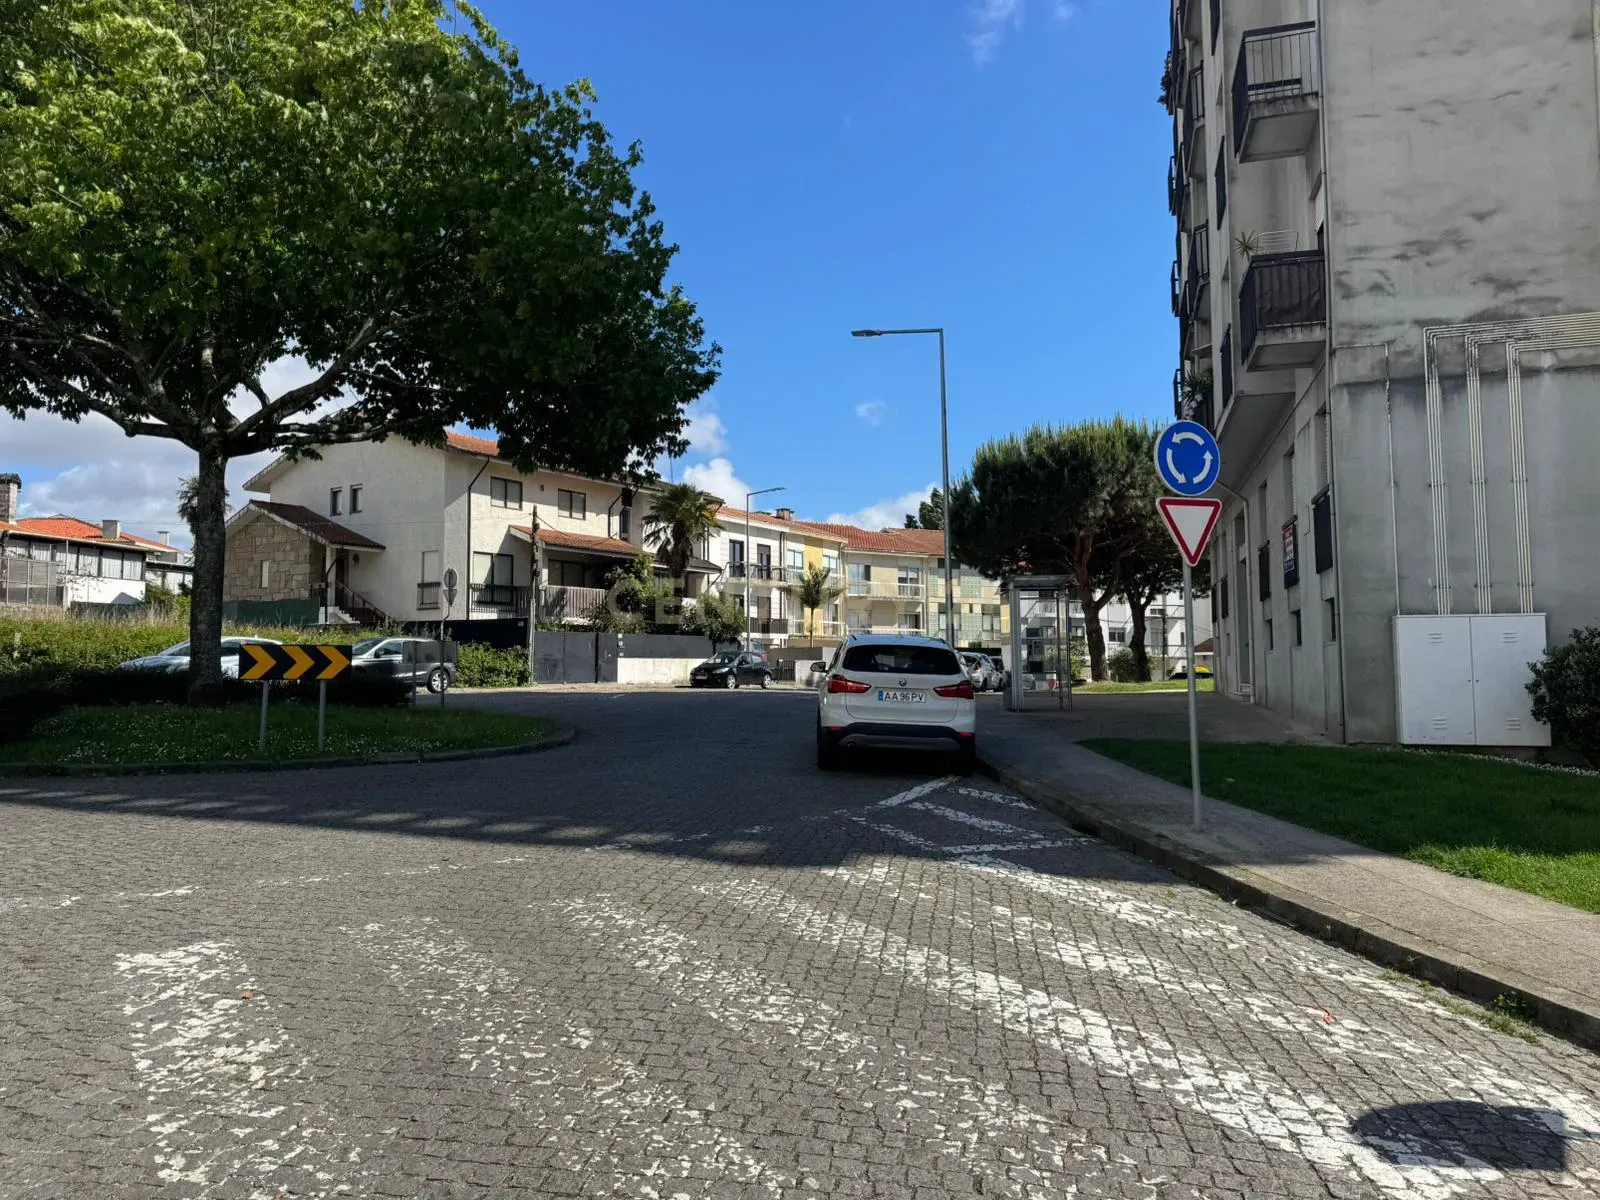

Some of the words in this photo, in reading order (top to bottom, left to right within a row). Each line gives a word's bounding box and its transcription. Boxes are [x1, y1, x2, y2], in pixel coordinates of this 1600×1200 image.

[885, 691, 899, 701] AA
[900, 692, 911, 701] 96
[911, 693, 924, 702] PV
